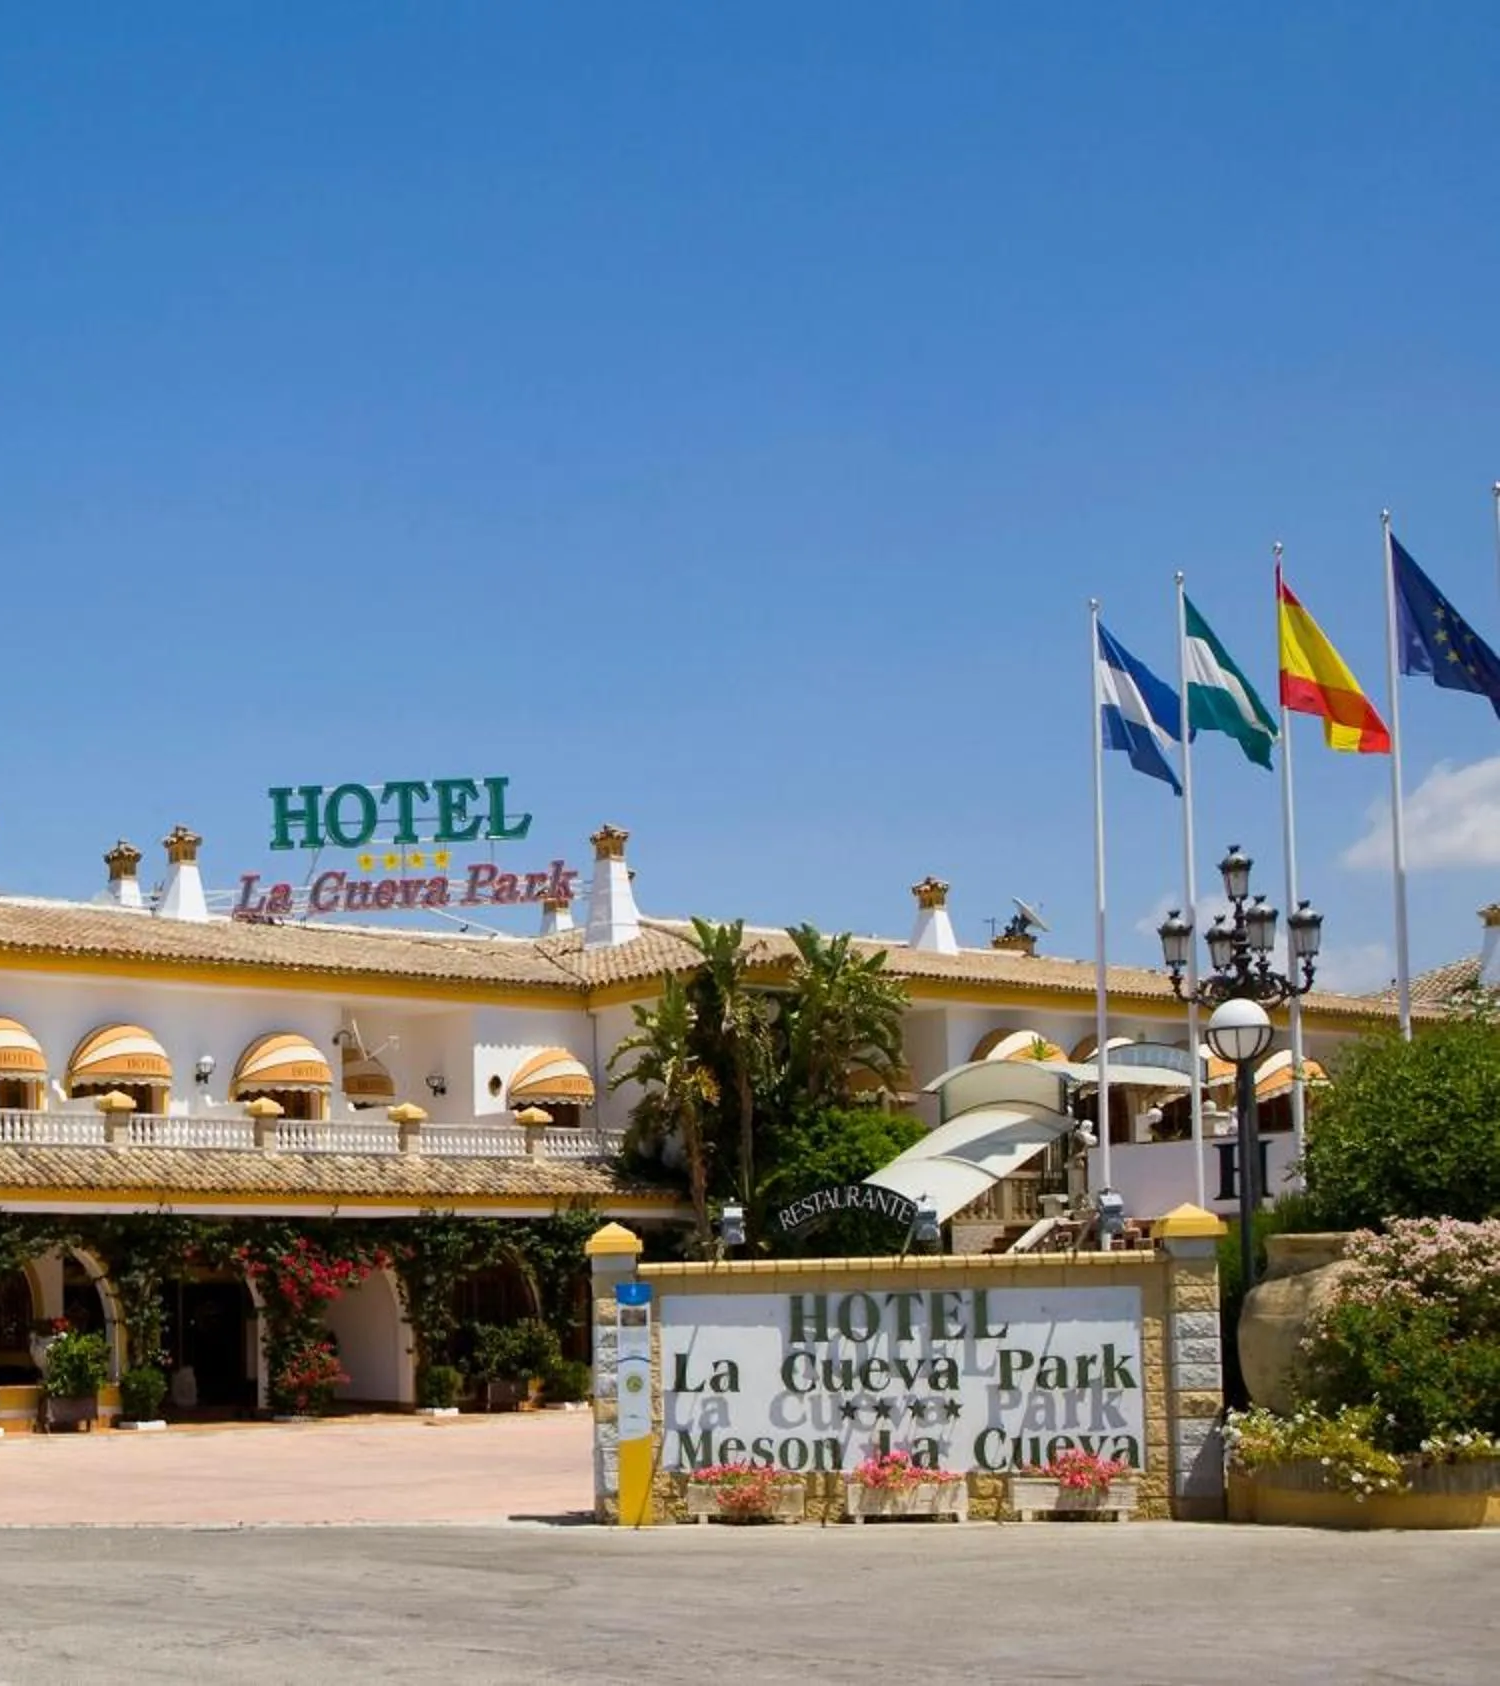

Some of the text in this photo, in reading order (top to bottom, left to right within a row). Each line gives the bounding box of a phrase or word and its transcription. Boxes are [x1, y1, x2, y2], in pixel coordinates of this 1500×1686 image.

[268, 777, 532, 850] HOTEL
[232, 860, 578, 917] La Cueva Park
[127, 1059, 161, 1072] HOTEL
[778, 1185, 918, 1231] RESTAURANTE
[789, 1289, 1009, 1343] HOTEL
[674, 1344, 1138, 1394] La Cueva Park
[677, 1428, 843, 1470] Meson
[973, 1427, 1141, 1470] Cueva
